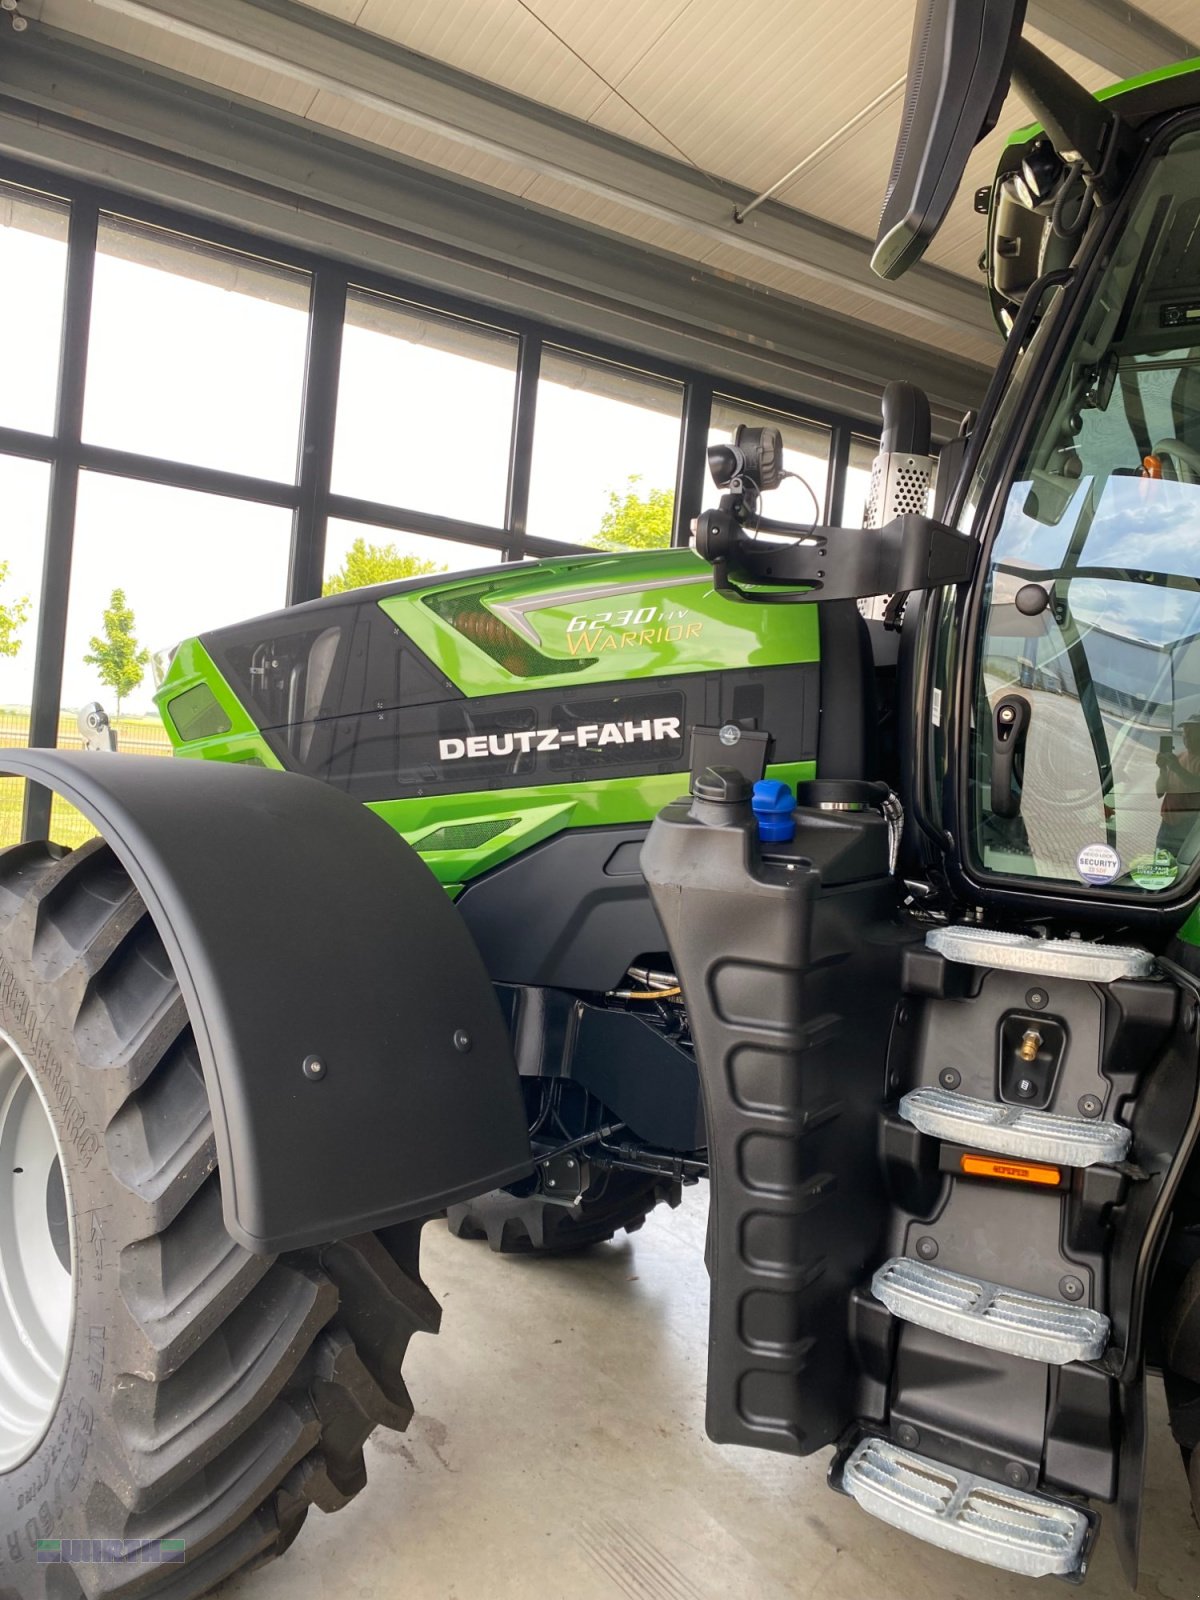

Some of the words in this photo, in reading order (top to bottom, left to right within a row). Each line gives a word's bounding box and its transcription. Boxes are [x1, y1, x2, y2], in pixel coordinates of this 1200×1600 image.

[566, 606, 658, 633] 6230
[566, 622, 703, 656] WARRIOR
[438, 716, 681, 760] DEUTZ-FAHR
[1079, 857, 1117, 869] SECURITY
